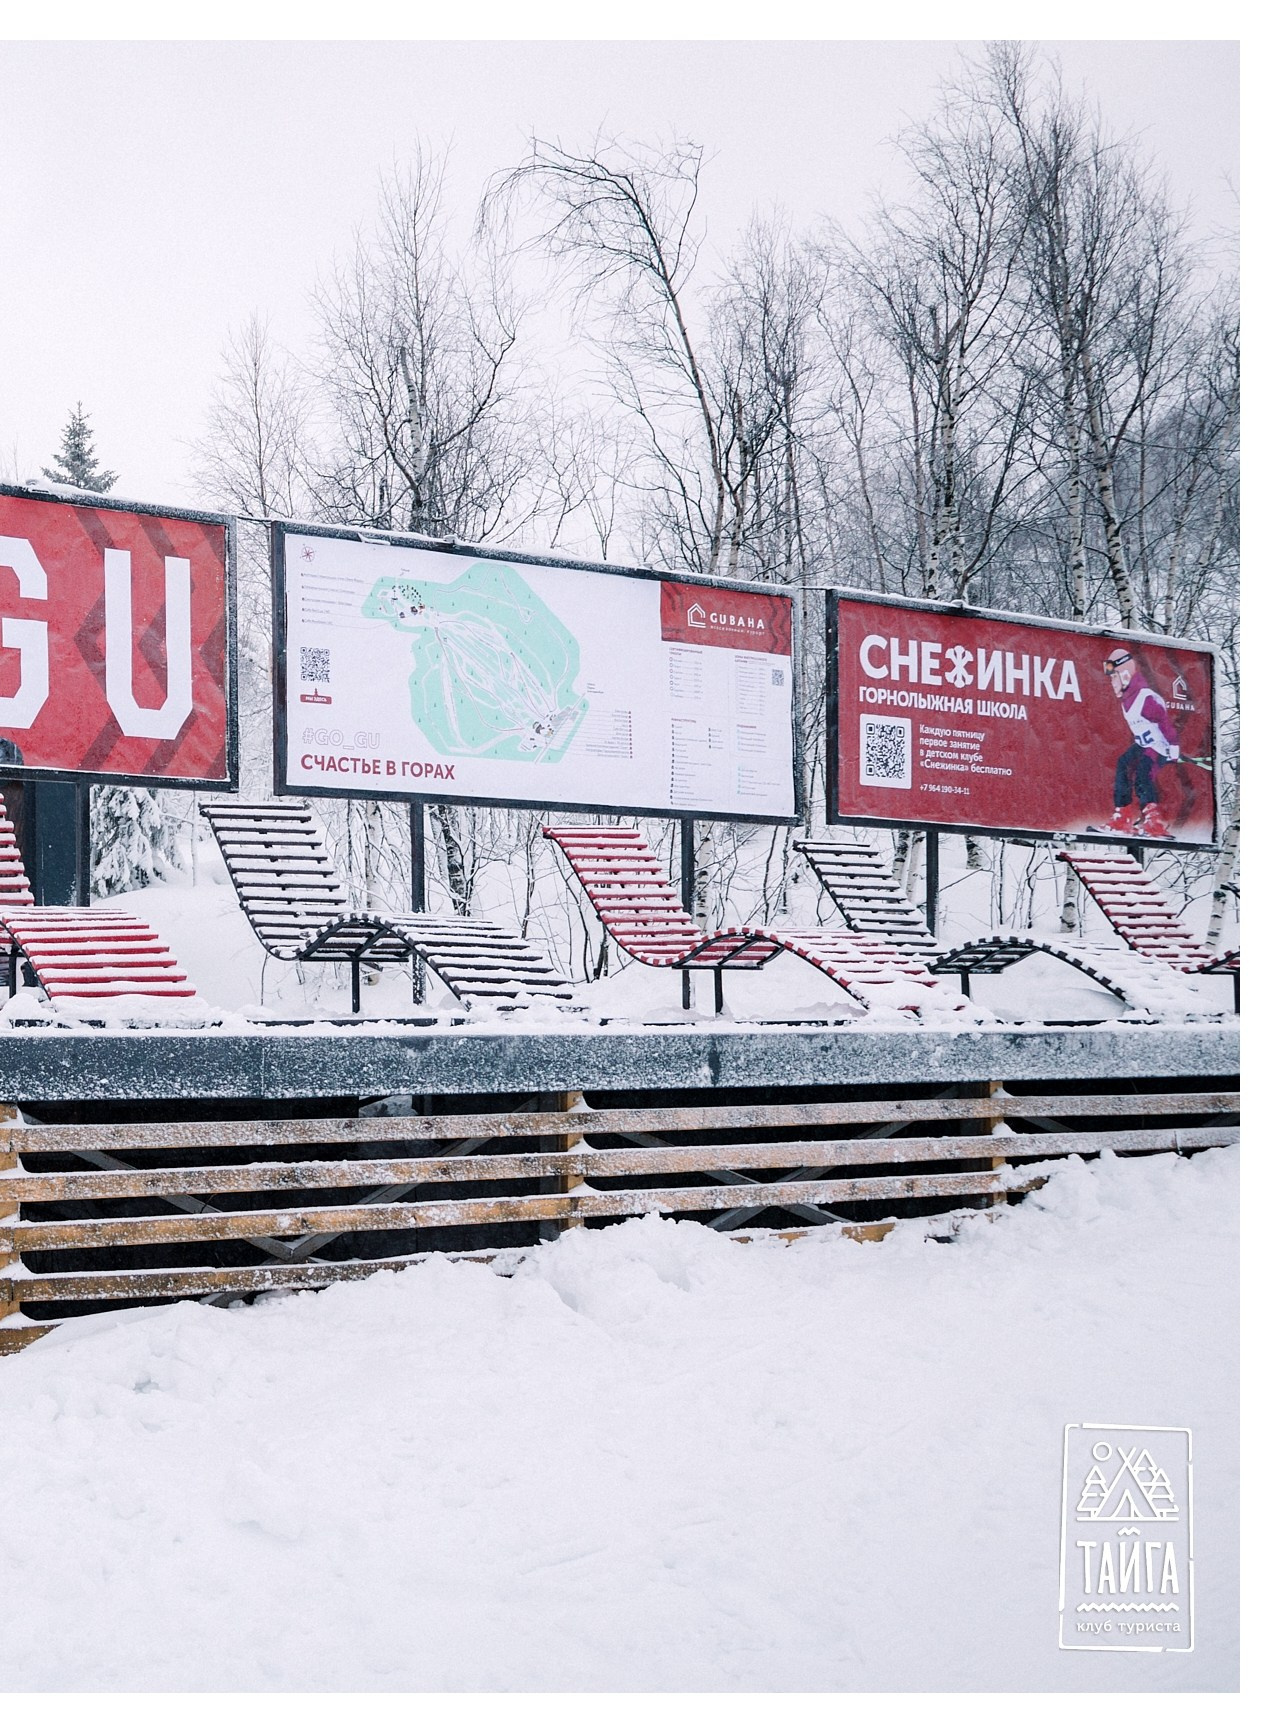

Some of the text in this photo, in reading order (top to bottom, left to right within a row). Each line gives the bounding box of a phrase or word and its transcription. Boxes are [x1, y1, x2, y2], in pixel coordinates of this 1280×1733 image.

[709, 612, 765, 630] GUBAHA
[859, 686, 1028, 721] ГОРНОЛЫЖНАЯ ШКОЛА
[1165, 701, 1195, 711] GUBAHA
[302, 727, 381, 750] #GO_GU
[919, 724, 985, 742] Каждую пятницу
[919, 737, 981, 751] первое занятие
[925, 749, 959, 759] детском
[960, 752, 983, 763] клубе
[300, 753, 456, 780] СЧАСТЬЕ В ГОРАХ
[919, 759, 1012, 776] «Снежинка» бесплатно
